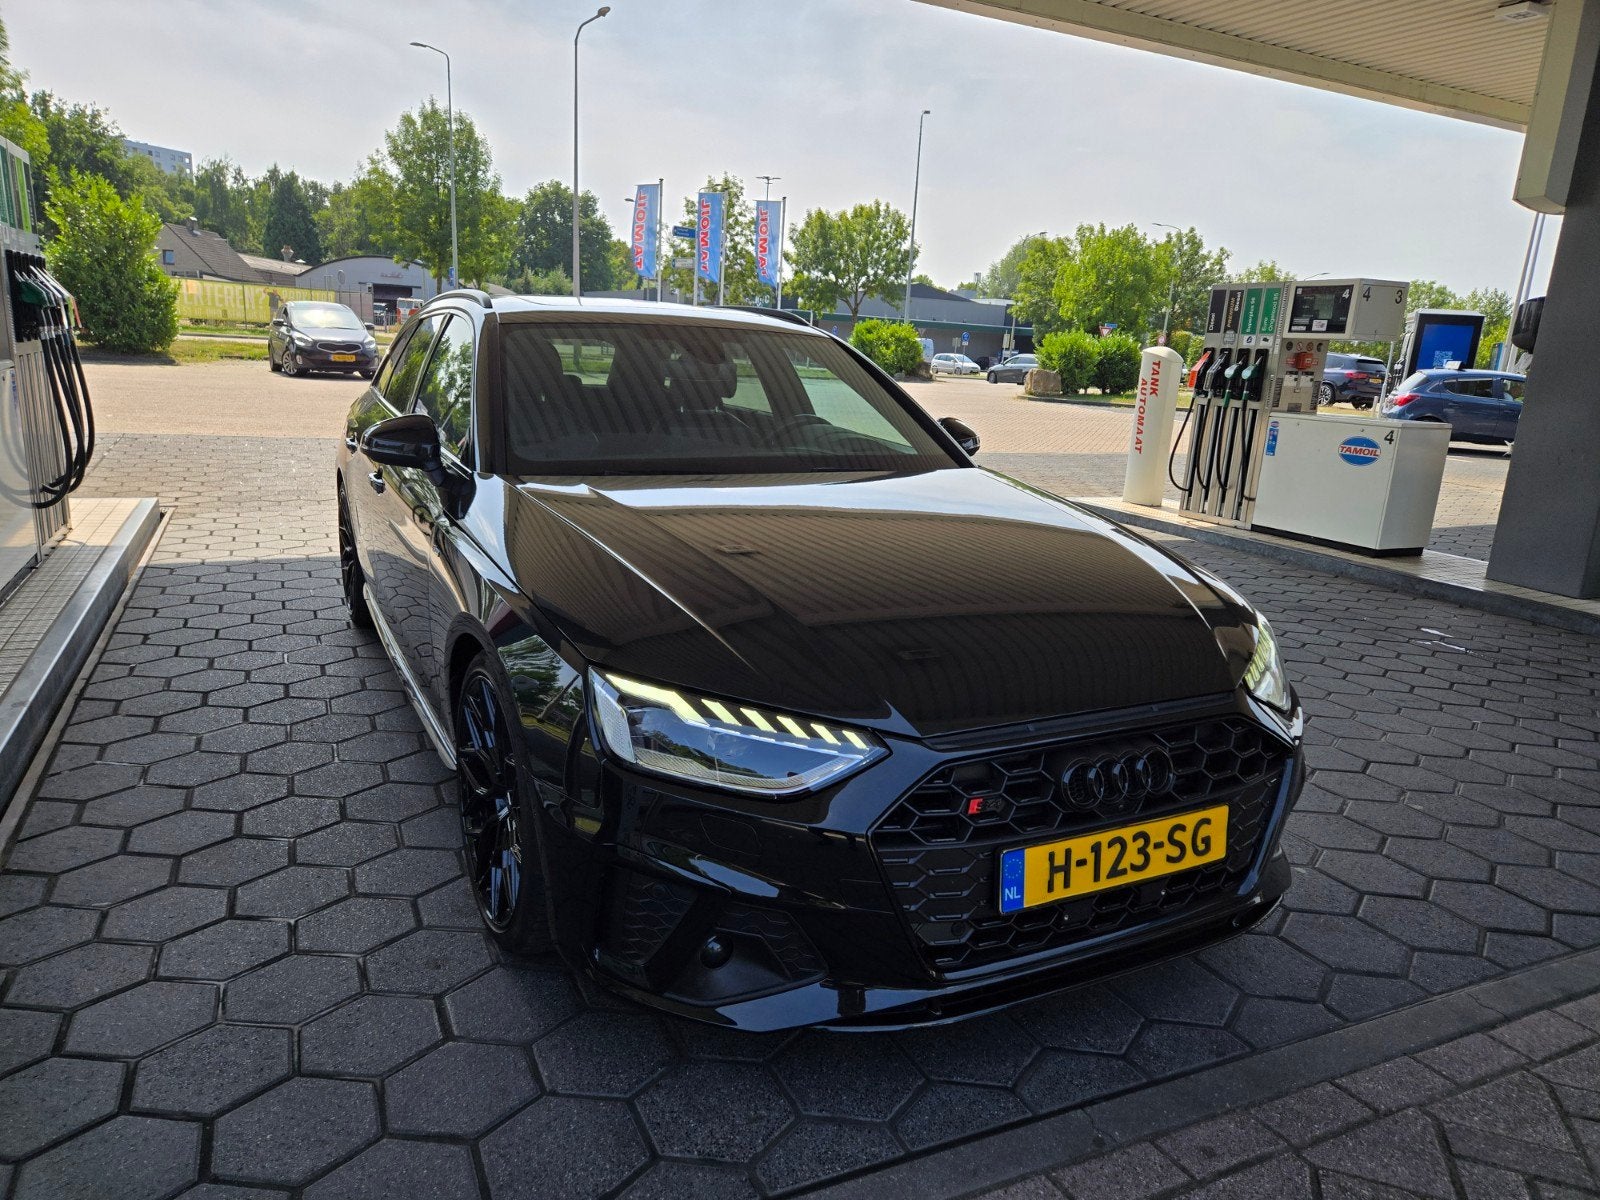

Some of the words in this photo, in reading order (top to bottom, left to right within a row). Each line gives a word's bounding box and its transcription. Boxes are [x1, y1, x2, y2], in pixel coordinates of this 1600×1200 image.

[1342, 288, 1350, 299] 4
[1362, 286, 1371, 302] 4
[1395, 289, 1403, 304] 3
[1149, 360, 1161, 398] TANK
[1135, 378, 1148, 455] AUTOMAAT
[1384, 430, 1395, 445] 4
[1340, 445, 1379, 457] TAMOIL
[1047, 817, 1212, 894] H-123-SG
[1004, 885, 1021, 901] NL
